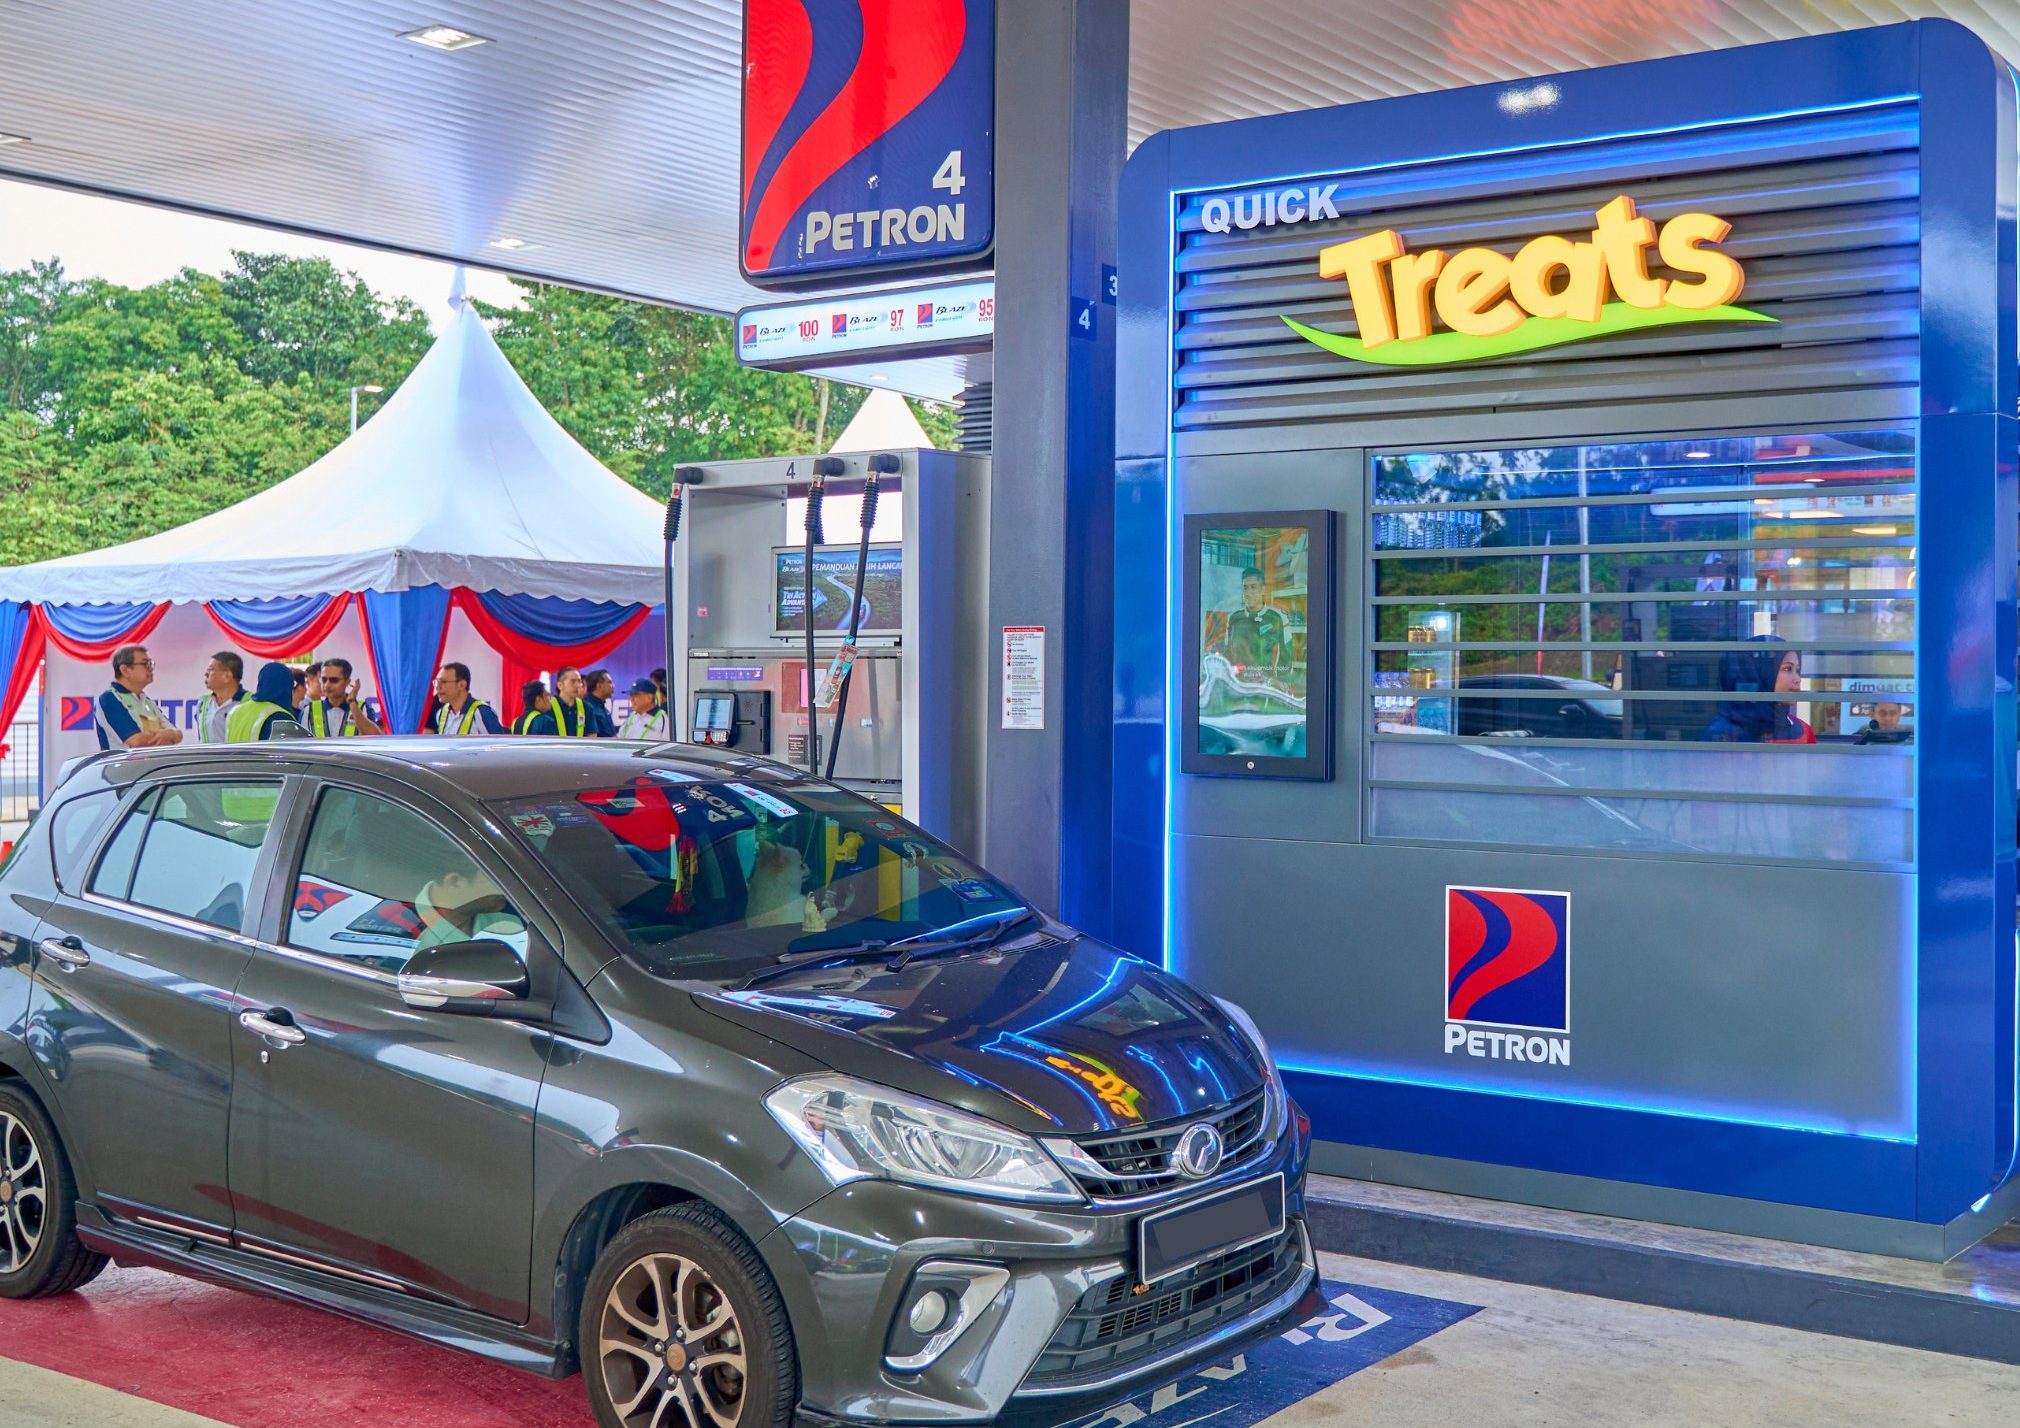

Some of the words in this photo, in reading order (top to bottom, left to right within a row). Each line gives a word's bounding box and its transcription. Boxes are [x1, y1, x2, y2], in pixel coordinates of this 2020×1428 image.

[932, 150, 966, 195] 4
[1201, 183, 1340, 235] QUICK
[805, 203, 965, 254] PETRON
[1319, 194, 1745, 349] Treats
[1109, 275, 1117, 296] 3
[890, 309, 904, 327] 97
[979, 299, 993, 316] 95
[798, 320, 819, 337] 100
[1079, 308, 1090, 330] 4
[786, 461, 796, 479] 4
[1444, 1023, 1570, 1066] PETRON
